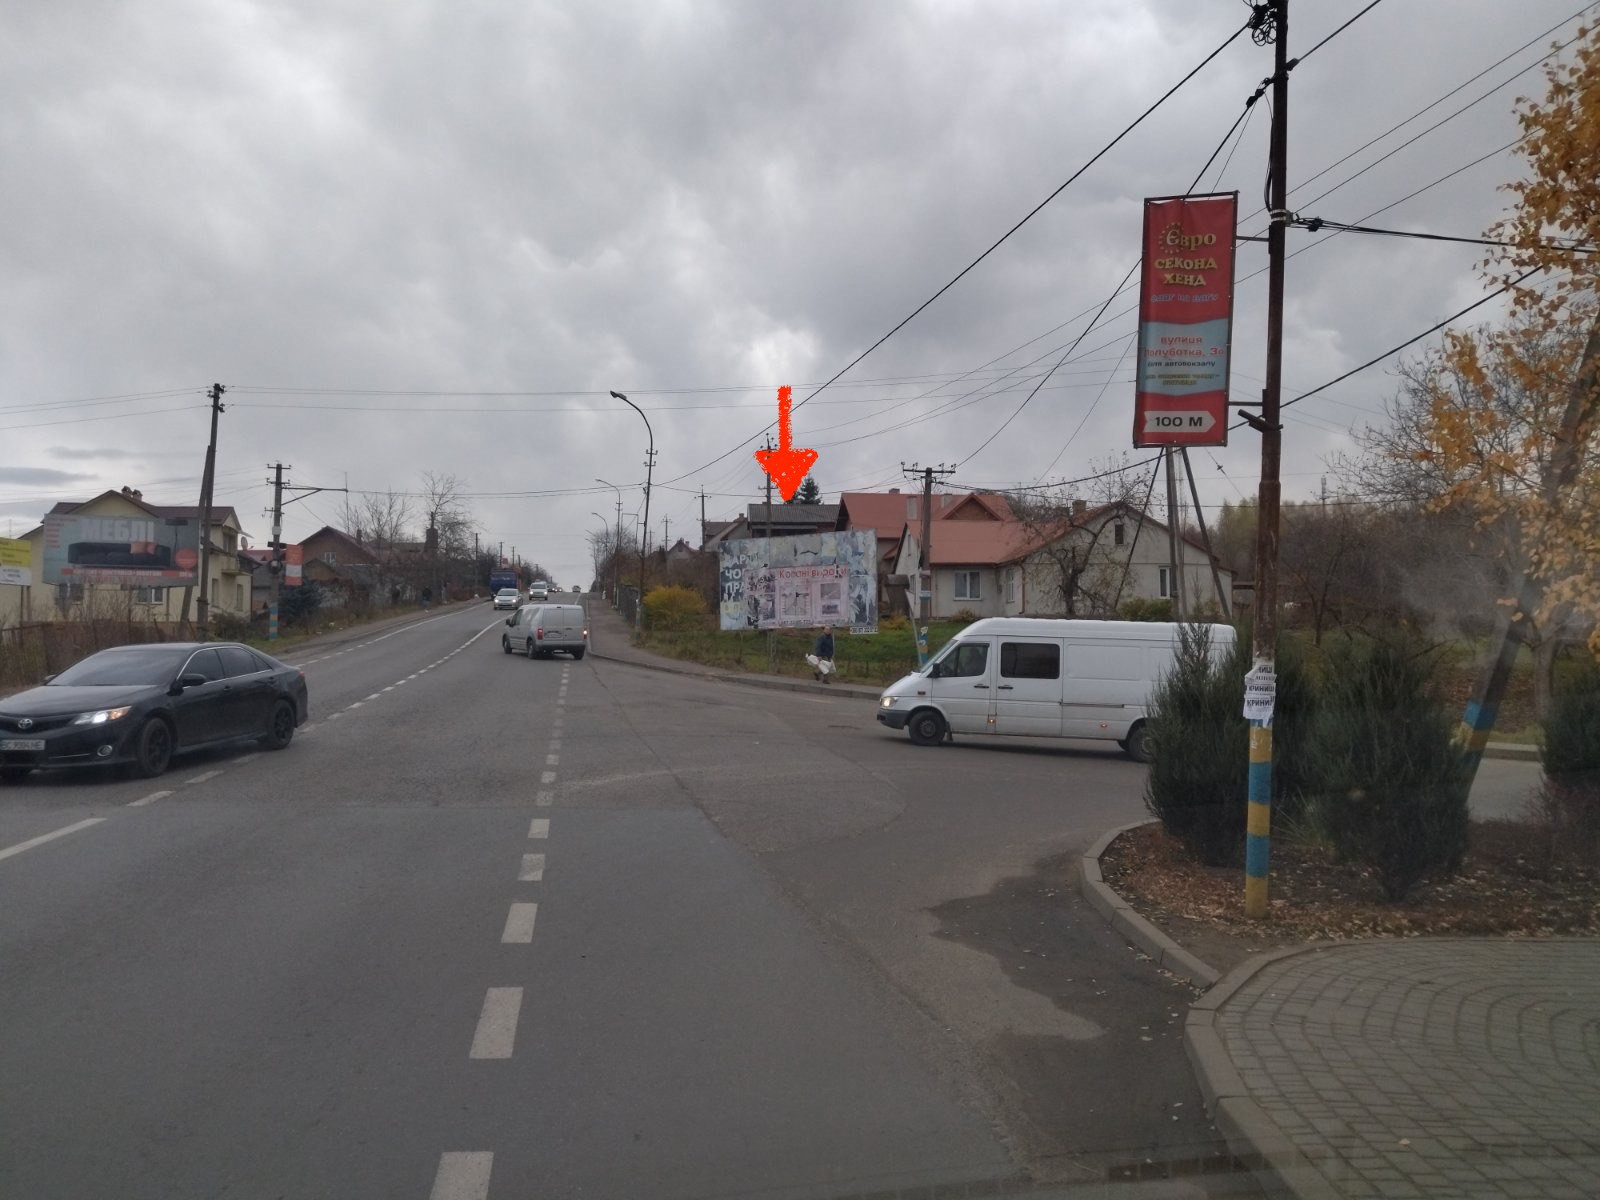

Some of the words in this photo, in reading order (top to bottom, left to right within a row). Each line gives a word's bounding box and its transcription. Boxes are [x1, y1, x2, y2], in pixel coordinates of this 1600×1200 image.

[1154, 257, 1218, 271] СЕКОНД
[1163, 272, 1207, 287] ХЕНД
[1161, 336, 1202, 345] вулиця
[1155, 416, 1183, 427] 100
[82, 519, 154, 542] МЕБЛІ
